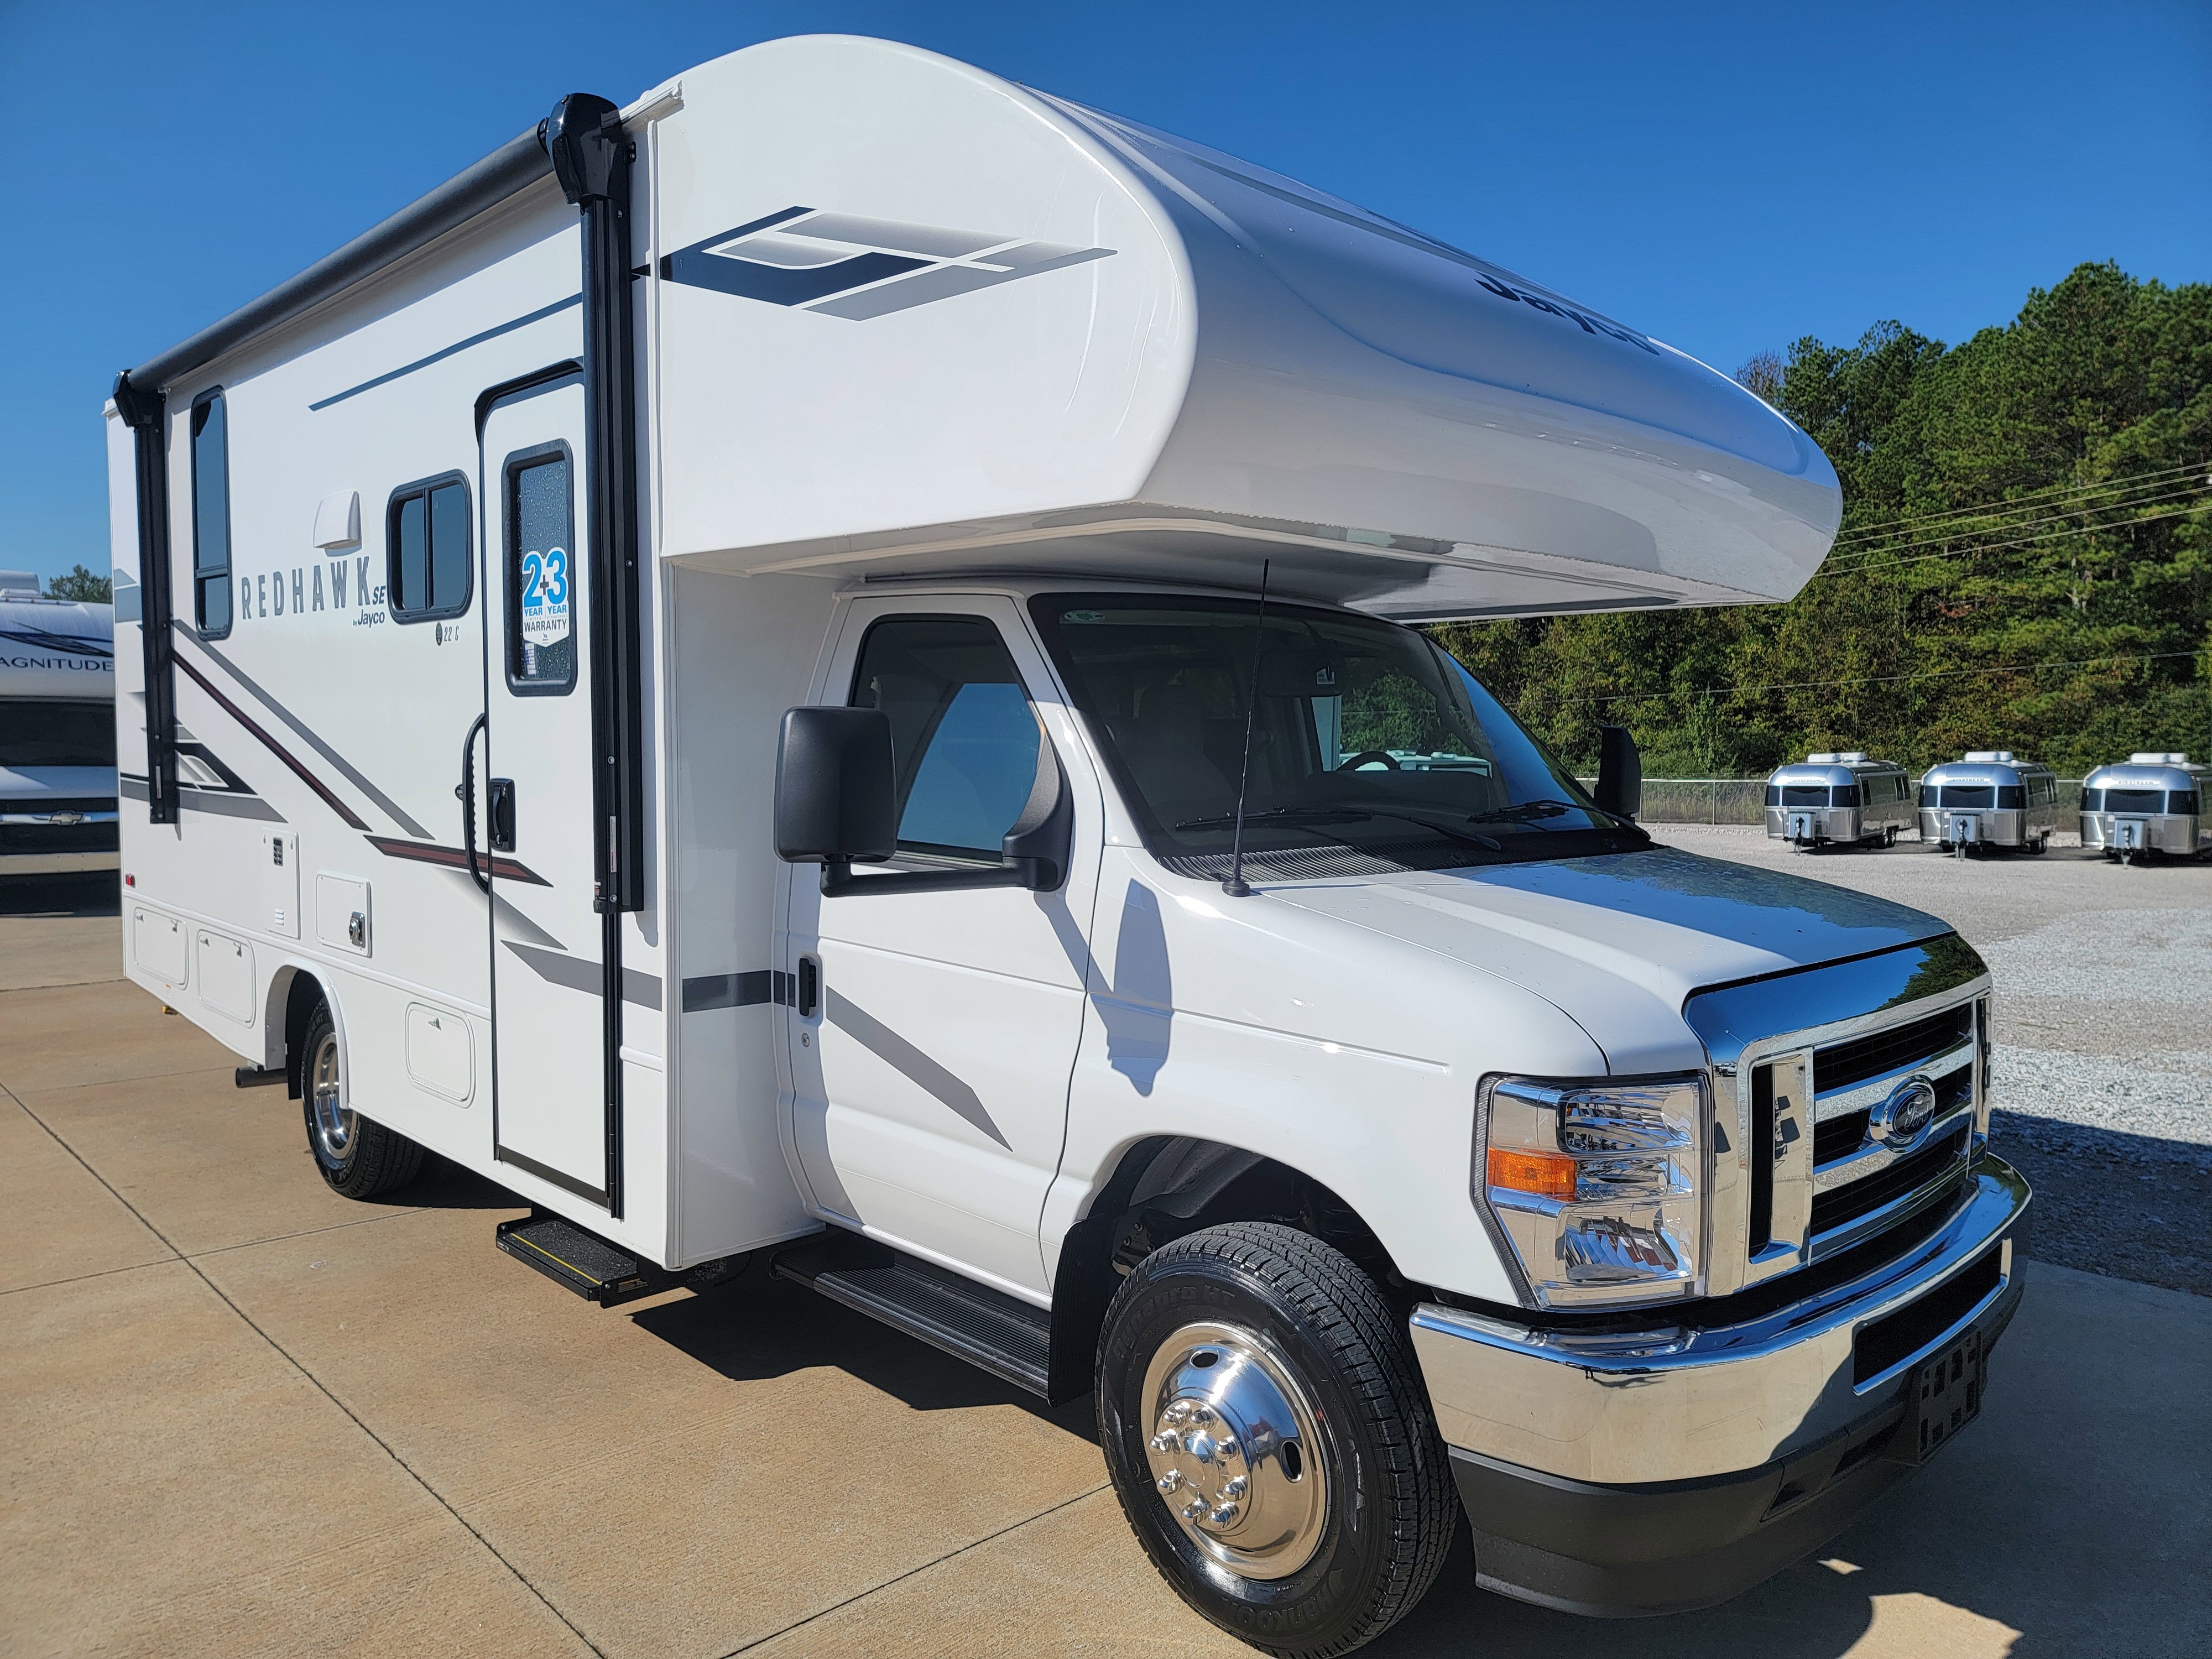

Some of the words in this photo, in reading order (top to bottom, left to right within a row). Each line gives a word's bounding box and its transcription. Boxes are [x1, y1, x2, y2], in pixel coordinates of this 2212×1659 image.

[1474, 270, 1660, 356] Jayco
[241, 556, 371, 619] REDHAWK
[372, 586, 386, 605] SE
[353, 619, 358, 628] by
[357, 609, 385, 628] Jayco
[524, 607, 542, 617] YEAR
[547, 605, 567, 615] YEAR
[444, 626, 452, 641] 22
[455, 625, 459, 641] C
[524, 619, 567, 632] WARRANTY
[1904, 1099, 1929, 1129] Ford
